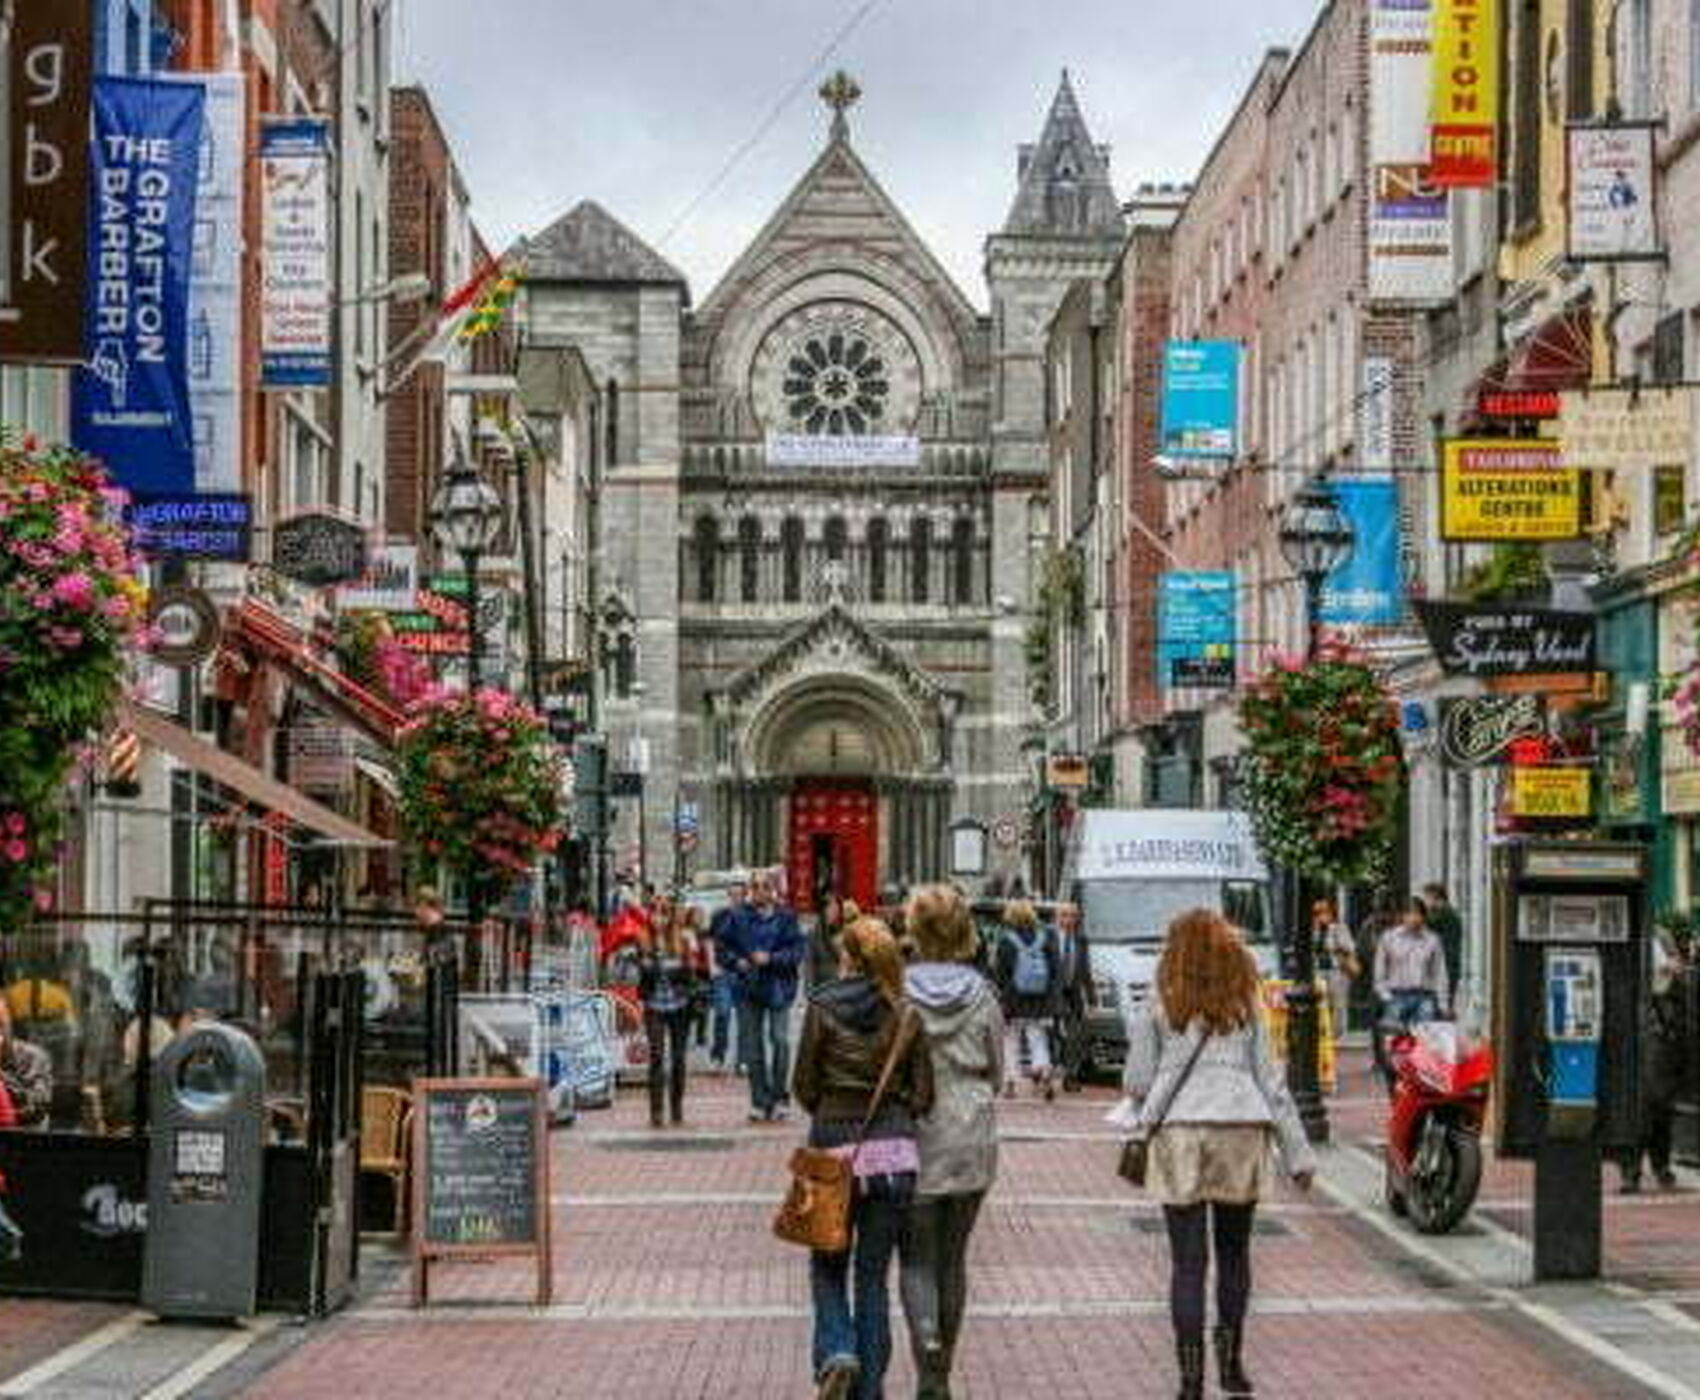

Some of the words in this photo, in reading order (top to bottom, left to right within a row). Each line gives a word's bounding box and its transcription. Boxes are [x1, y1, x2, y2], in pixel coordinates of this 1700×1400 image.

[104, 134, 171, 165] THE
[97, 167, 130, 333] BARBER
[135, 169, 170, 363] GRAFTON
[1458, 479, 1570, 496] ALTERATIONS
[1480, 500, 1545, 518] CENTRE
